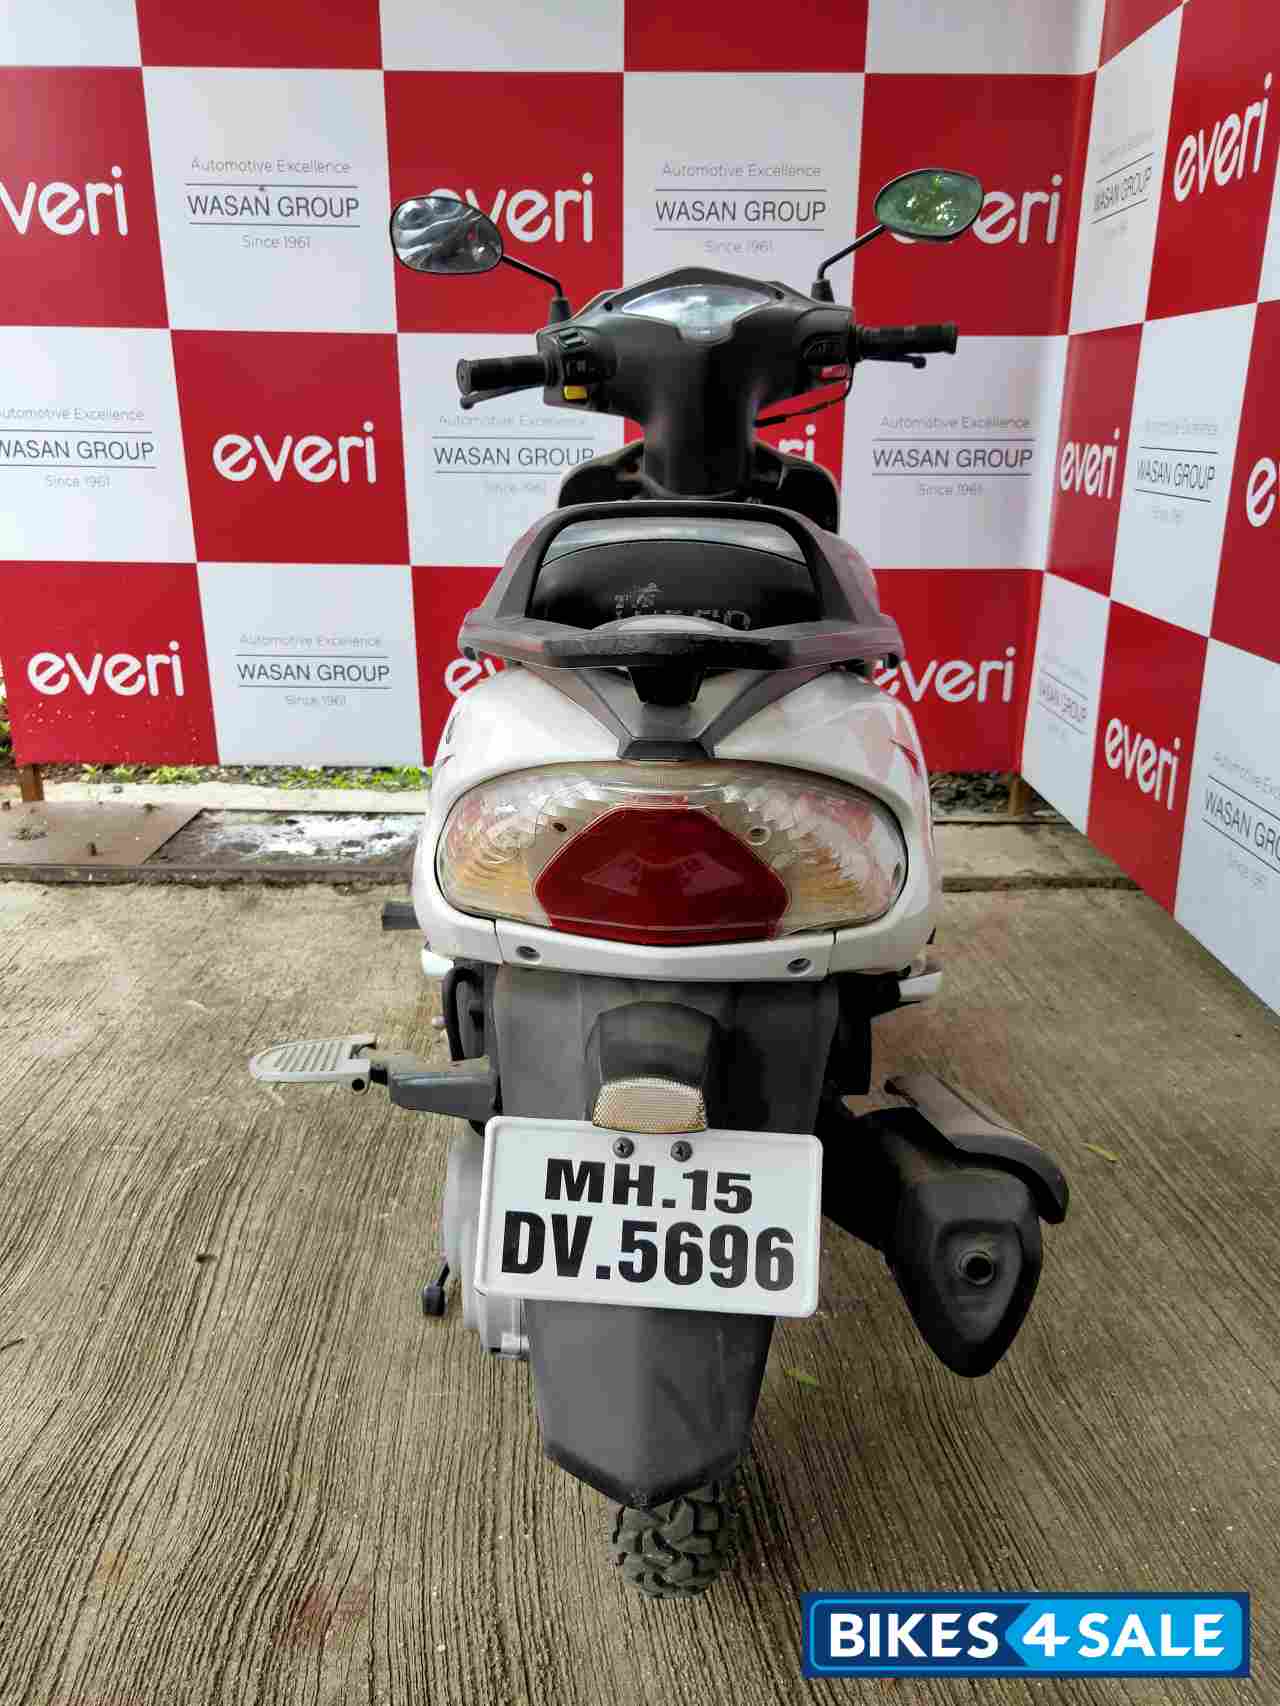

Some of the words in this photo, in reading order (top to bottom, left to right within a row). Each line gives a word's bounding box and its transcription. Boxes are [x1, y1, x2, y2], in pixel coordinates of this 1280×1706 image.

[1173, 72, 1273, 202] everi
[191, 157, 272, 174] Automotive
[276, 159, 351, 175] Excellence
[663, 160, 744, 177] Automotive
[748, 163, 822, 177] Excellence
[187, 194, 270, 217] WASAN
[277, 195, 360, 219] GROUP
[430, 171, 593, 243] veri
[655, 200, 736, 222] WASAN
[744, 200, 827, 222] GROUP
[241, 234, 280, 249] Since
[283, 235, 312, 249] 1961
[77, 440, 155, 461] GROUP
[212, 421, 377, 484] everi
[433, 447, 510, 466] WASAN
[518, 447, 595, 467] GROUP
[872, 448, 950, 468] WASAN
[956, 448, 1033, 468] GROUP
[1059, 428, 1120, 499] everi
[27, 641, 185, 697] everi
[236, 663, 311, 681] WASAN
[317, 664, 390, 682] GROUP
[1104, 718, 1182, 810] everi
[1205, 788, 1252, 838] WASAN
[544, 1157, 752, 1214] MH.15
[501, 1209, 795, 1292] DV.5696
